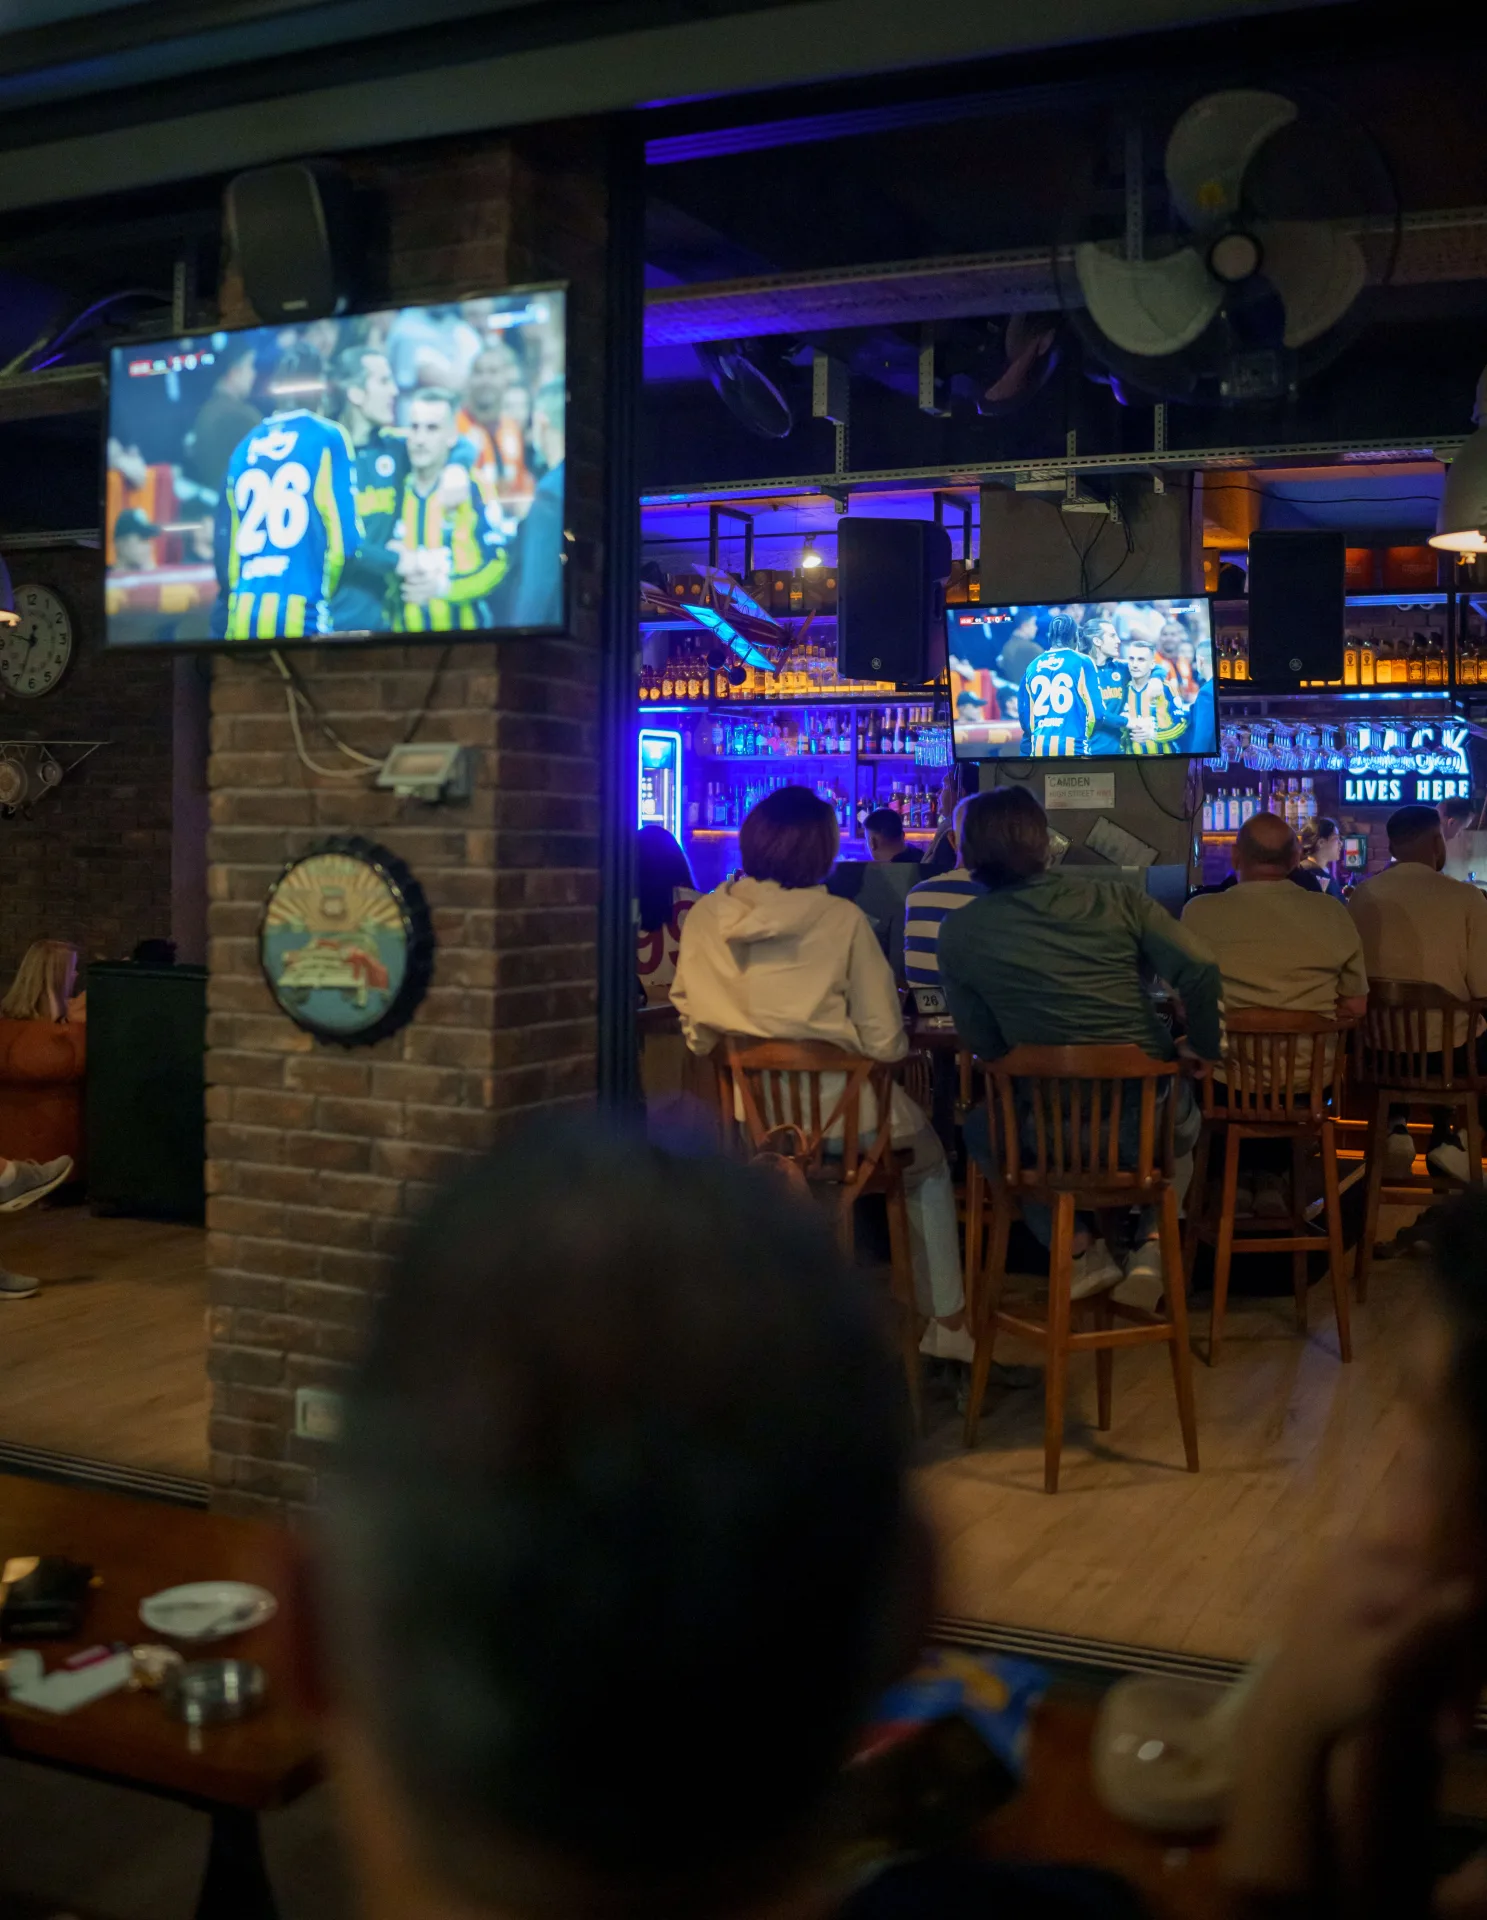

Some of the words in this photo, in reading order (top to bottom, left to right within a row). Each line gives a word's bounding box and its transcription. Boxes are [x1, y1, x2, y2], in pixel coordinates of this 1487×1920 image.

[234, 461, 311, 557] 26
[55, 611, 63, 624] 2
[44, 671, 52, 683] 5
[1030, 672, 1074, 717] 26
[1049, 776, 1091, 788] CAMDEN
[1067, 789, 1095, 798] STREET
[1345, 779, 1401, 801] LIVES
[1416, 779, 1470, 801] HERE
[922, 994, 939, 1007] 26
